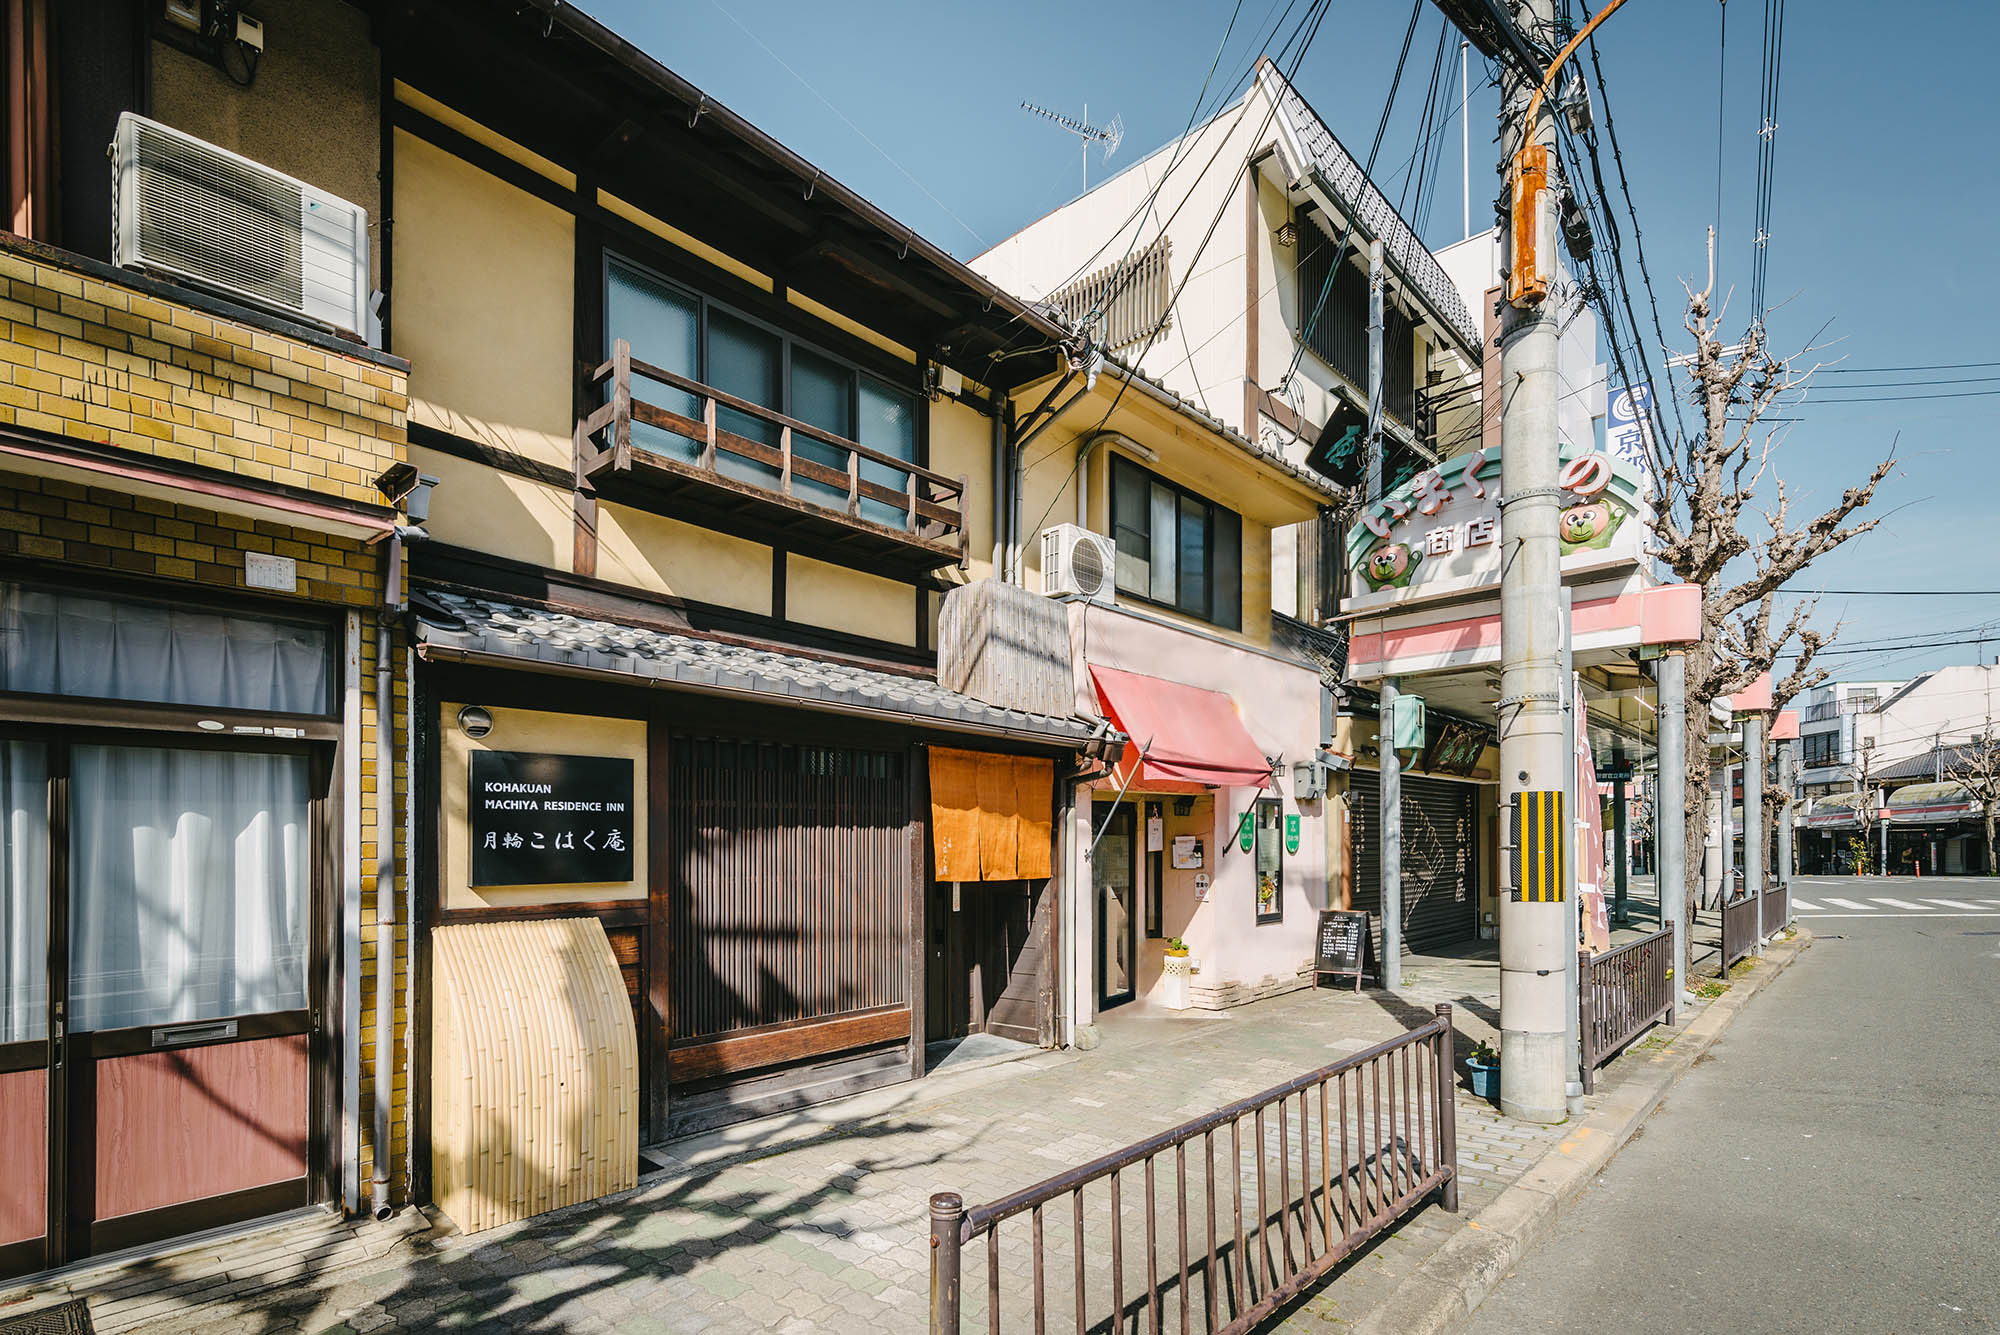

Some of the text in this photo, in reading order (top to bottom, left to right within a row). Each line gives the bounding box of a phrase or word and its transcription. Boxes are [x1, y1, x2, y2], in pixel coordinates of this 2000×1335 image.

[484, 782, 552, 794] KOHAKUAN
[484, 799, 625, 812] MACHIYA RESIDENCE INN
[483, 828, 626, 851] 月輪こはく庵
